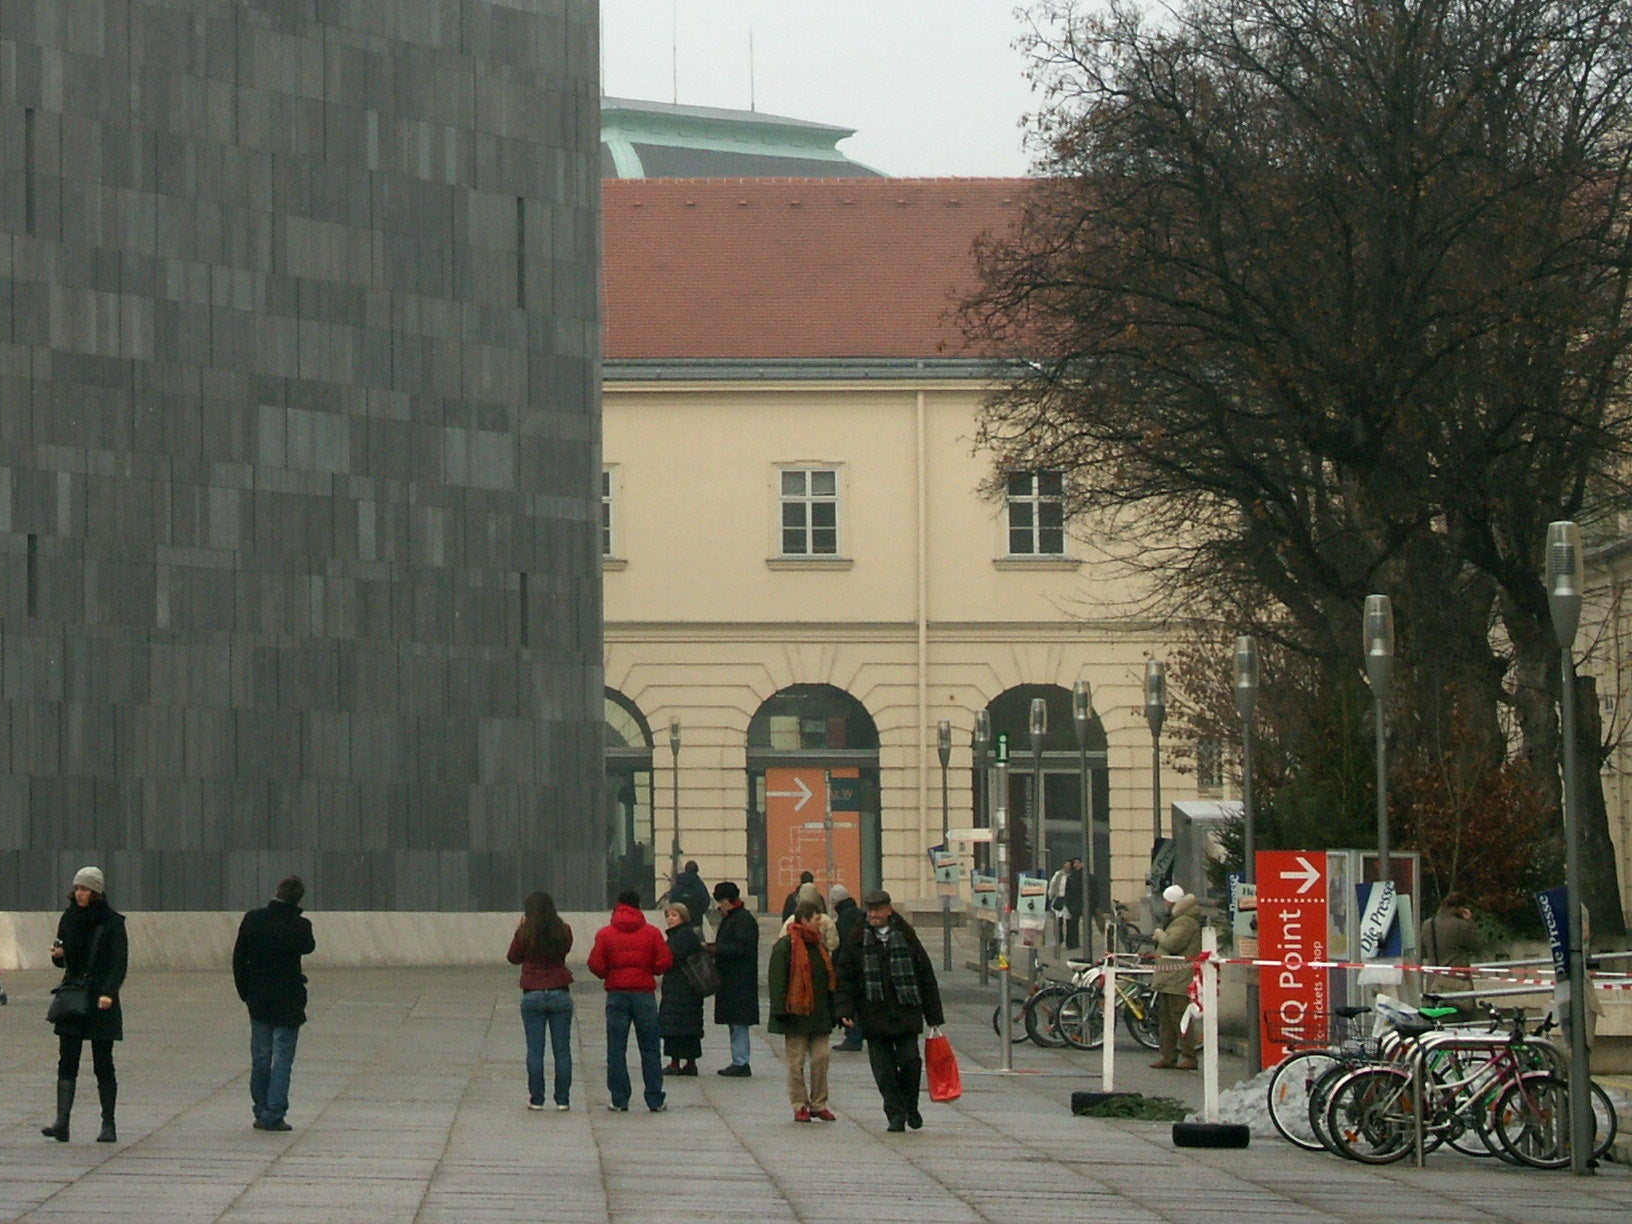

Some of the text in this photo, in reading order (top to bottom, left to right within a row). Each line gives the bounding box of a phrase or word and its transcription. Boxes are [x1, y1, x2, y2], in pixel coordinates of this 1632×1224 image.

[1361, 880, 1395, 953] Die Presse
[1539, 894, 1562, 948] Presse
[1278, 908, 1303, 989] Point
[1314, 981, 1324, 1019] Tickets
